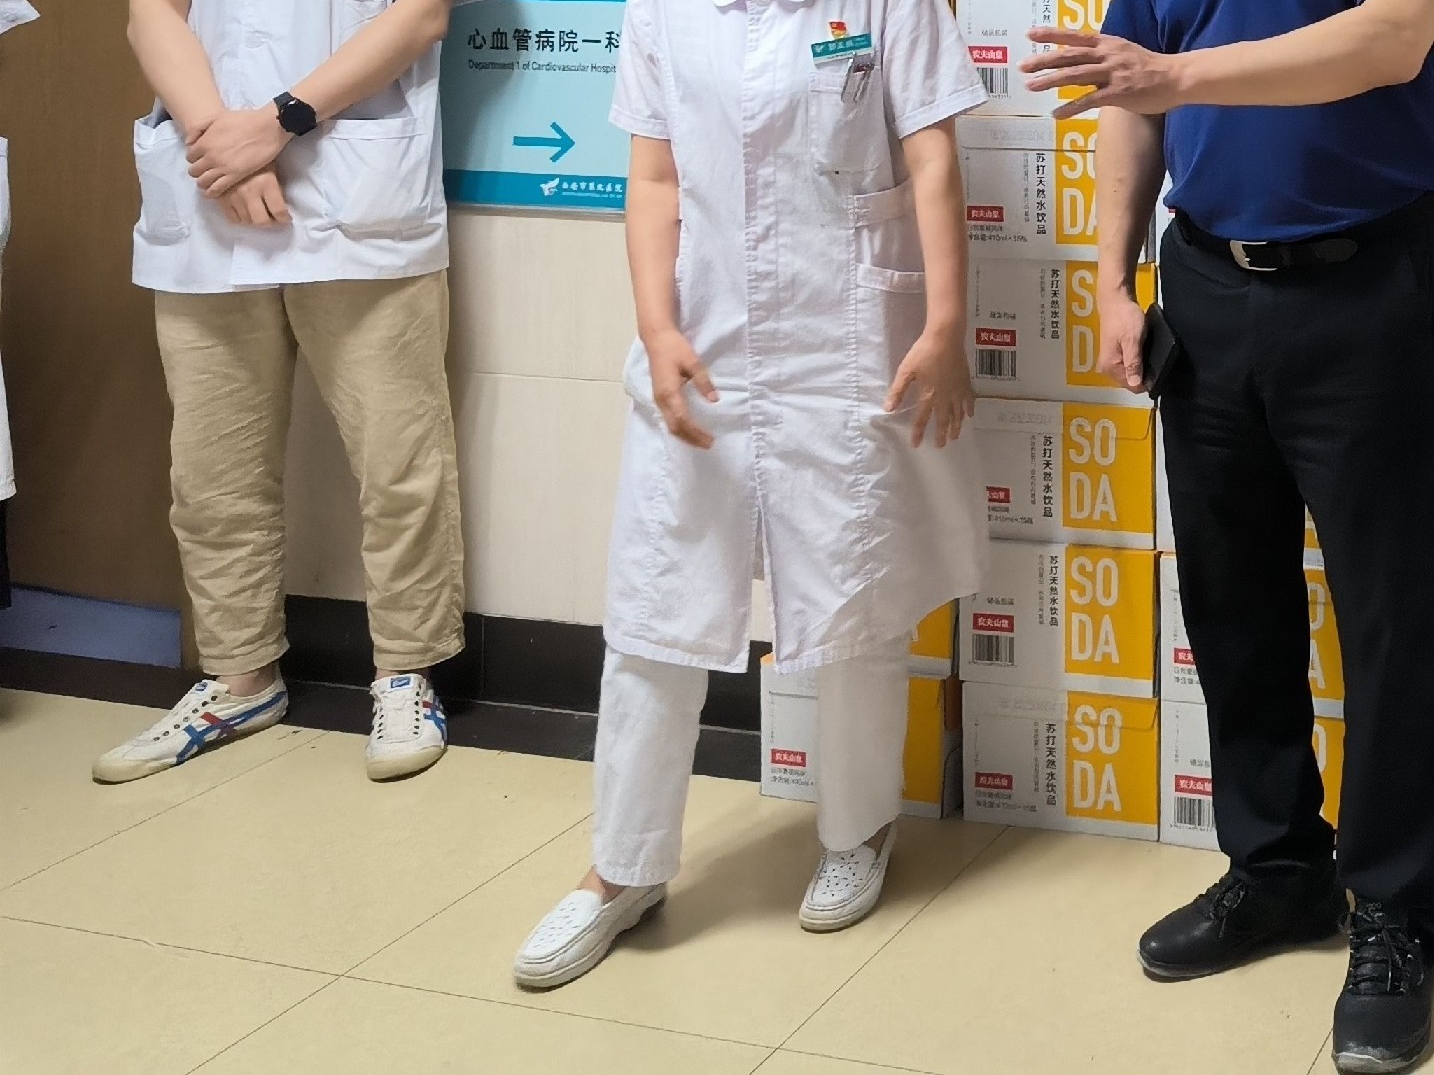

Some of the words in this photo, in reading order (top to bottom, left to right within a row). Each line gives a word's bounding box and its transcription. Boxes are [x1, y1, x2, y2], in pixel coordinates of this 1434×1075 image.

[467, 27, 620, 54] 心血管病院一科
[468, 59, 514, 72] Department
[522, 61, 530, 70] of
[531, 61, 588, 72] Cardiovascular
[590, 63, 616, 74] Hospit
[1036, 153, 1047, 235] 苏打天然水饮品
[1051, 269, 1060, 339] 苏打天然水饮品
[1071, 269, 1094, 317] S
[1072, 325, 1094, 373] D
[1069, 417, 1117, 466] SO
[1043, 435, 1053, 518] 苏打天然水饮品
[1070, 472, 1117, 522] DA
[1049, 555, 1058, 626] 苏打天然水饮品
[1070, 556, 1119, 607] SO
[1307, 582, 1325, 629] O
[1071, 613, 1120, 664] DA
[1308, 640, 1325, 689] A
[1072, 704, 1122, 756] SO
[1073, 759, 1123, 812] DA
